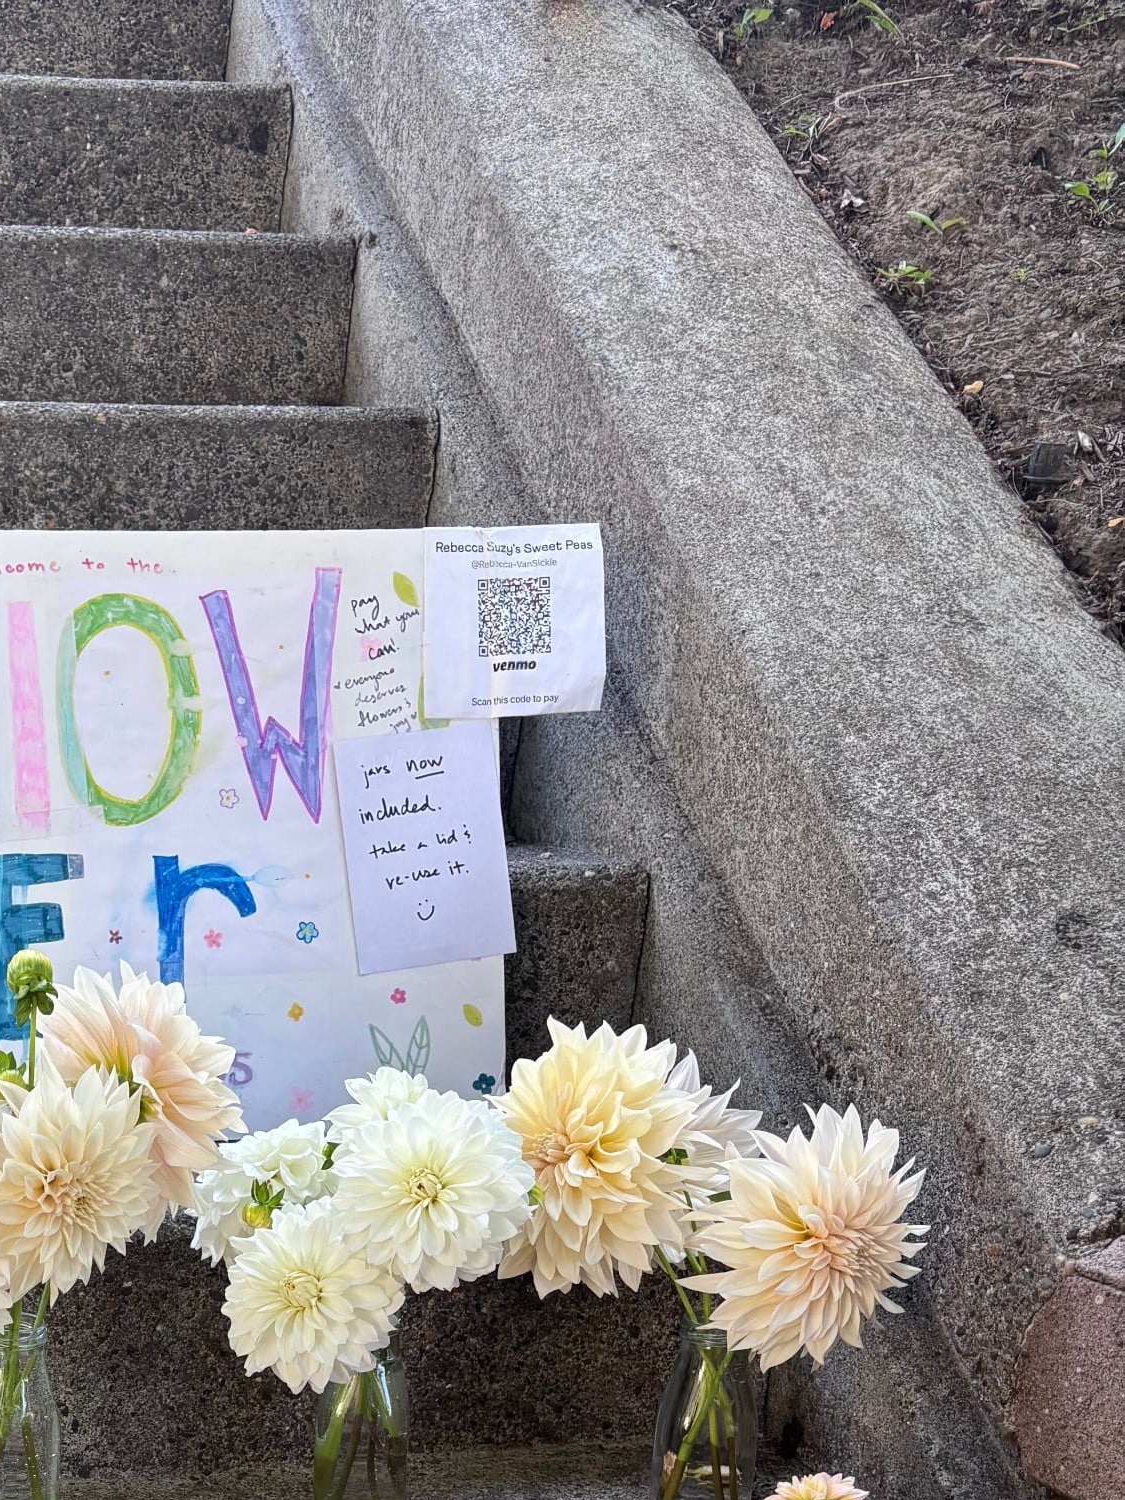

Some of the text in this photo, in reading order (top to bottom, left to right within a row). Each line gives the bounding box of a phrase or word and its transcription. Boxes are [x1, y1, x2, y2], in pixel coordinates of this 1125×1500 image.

[435, 540, 593, 556] Rebecca Suzy's Sweet Peas
[82, 557, 105, 570] to
[351, 595, 380, 620] pay
[355, 608, 420, 634] what you
[368, 638, 400, 661] can!
[493, 659, 537, 672] venmo
[345, 667, 395, 692] everyone
[355, 684, 407, 707] deserves
[471, 694, 559, 707] Scan this code to pay
[357, 705, 403, 727] flowers
[361, 756, 444, 789] jars now
[358, 794, 442, 824] included.
[369, 840, 406, 859] take
[417, 842, 428, 850] a
[435, 829, 458, 845] lid
[385, 861, 470, 890] re-use it.
